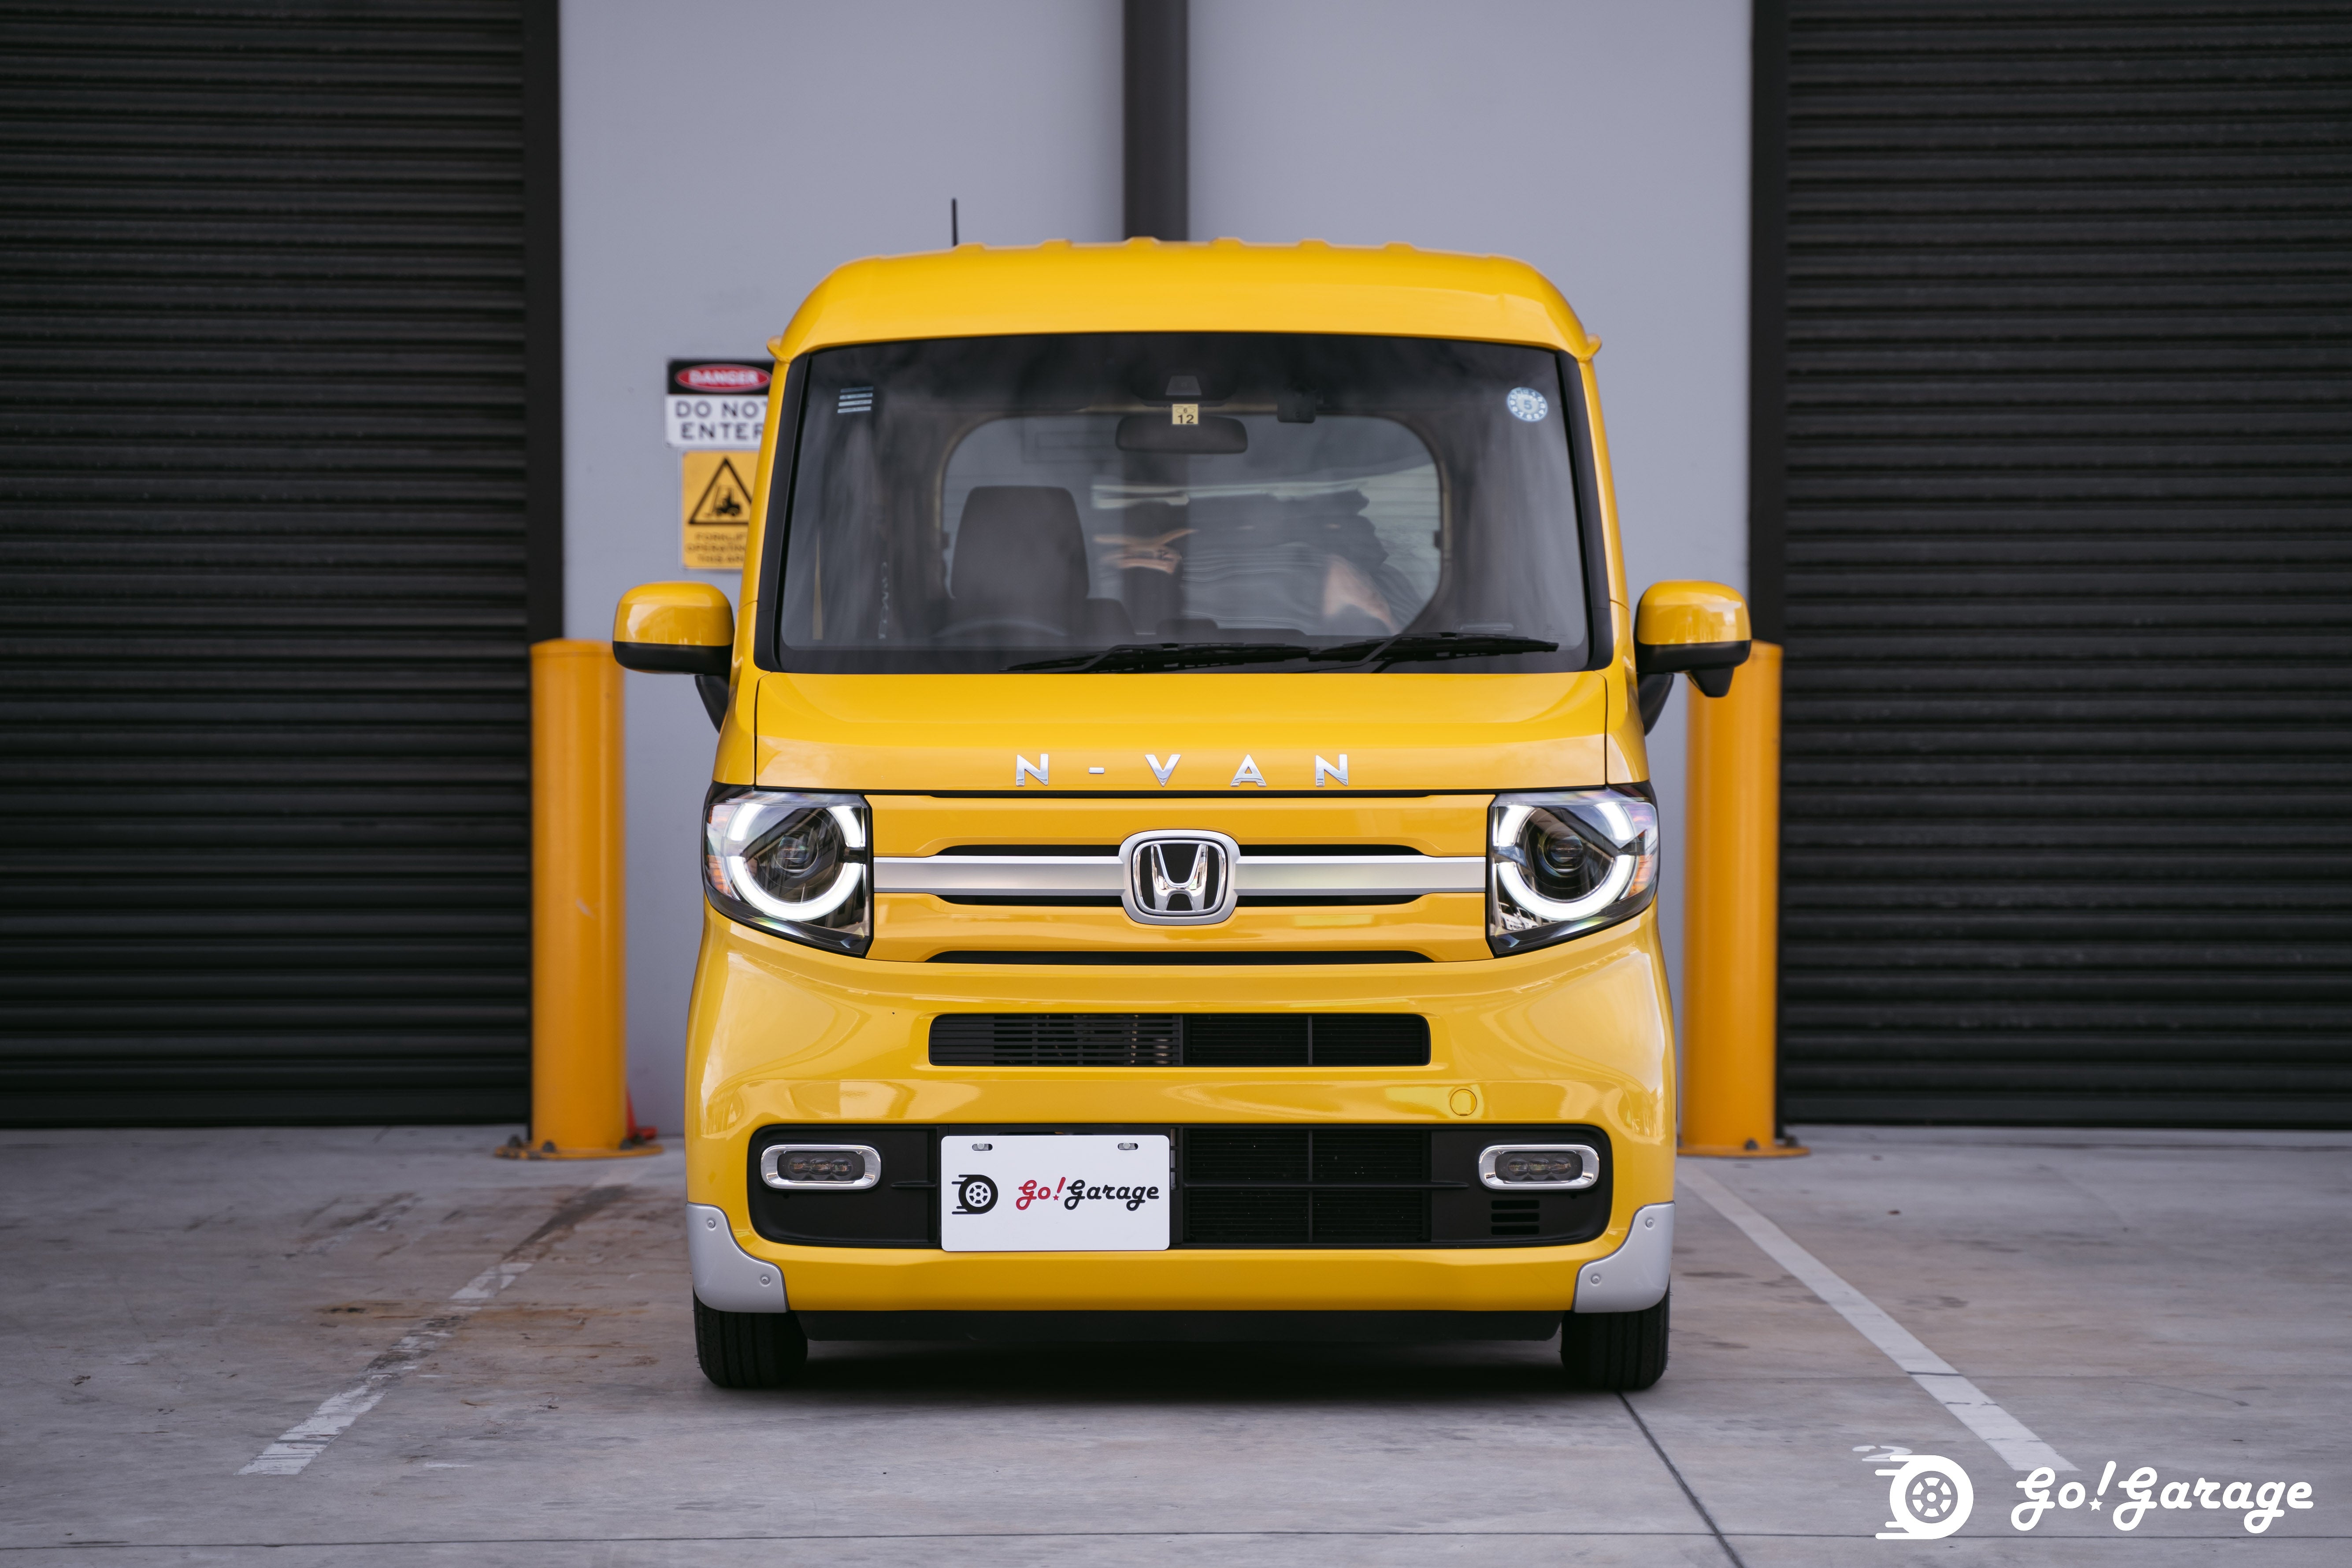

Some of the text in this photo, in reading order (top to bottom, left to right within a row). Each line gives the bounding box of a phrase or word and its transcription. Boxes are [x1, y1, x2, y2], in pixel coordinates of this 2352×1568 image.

[688, 369, 759, 385] DANGER
[675, 400, 712, 419] DO
[1524, 400, 1532, 410] 5
[1177, 414, 1195, 424] 12
[1016, 753, 1349, 787] N-VAN
[1852, 1445, 1913, 1462] 2
